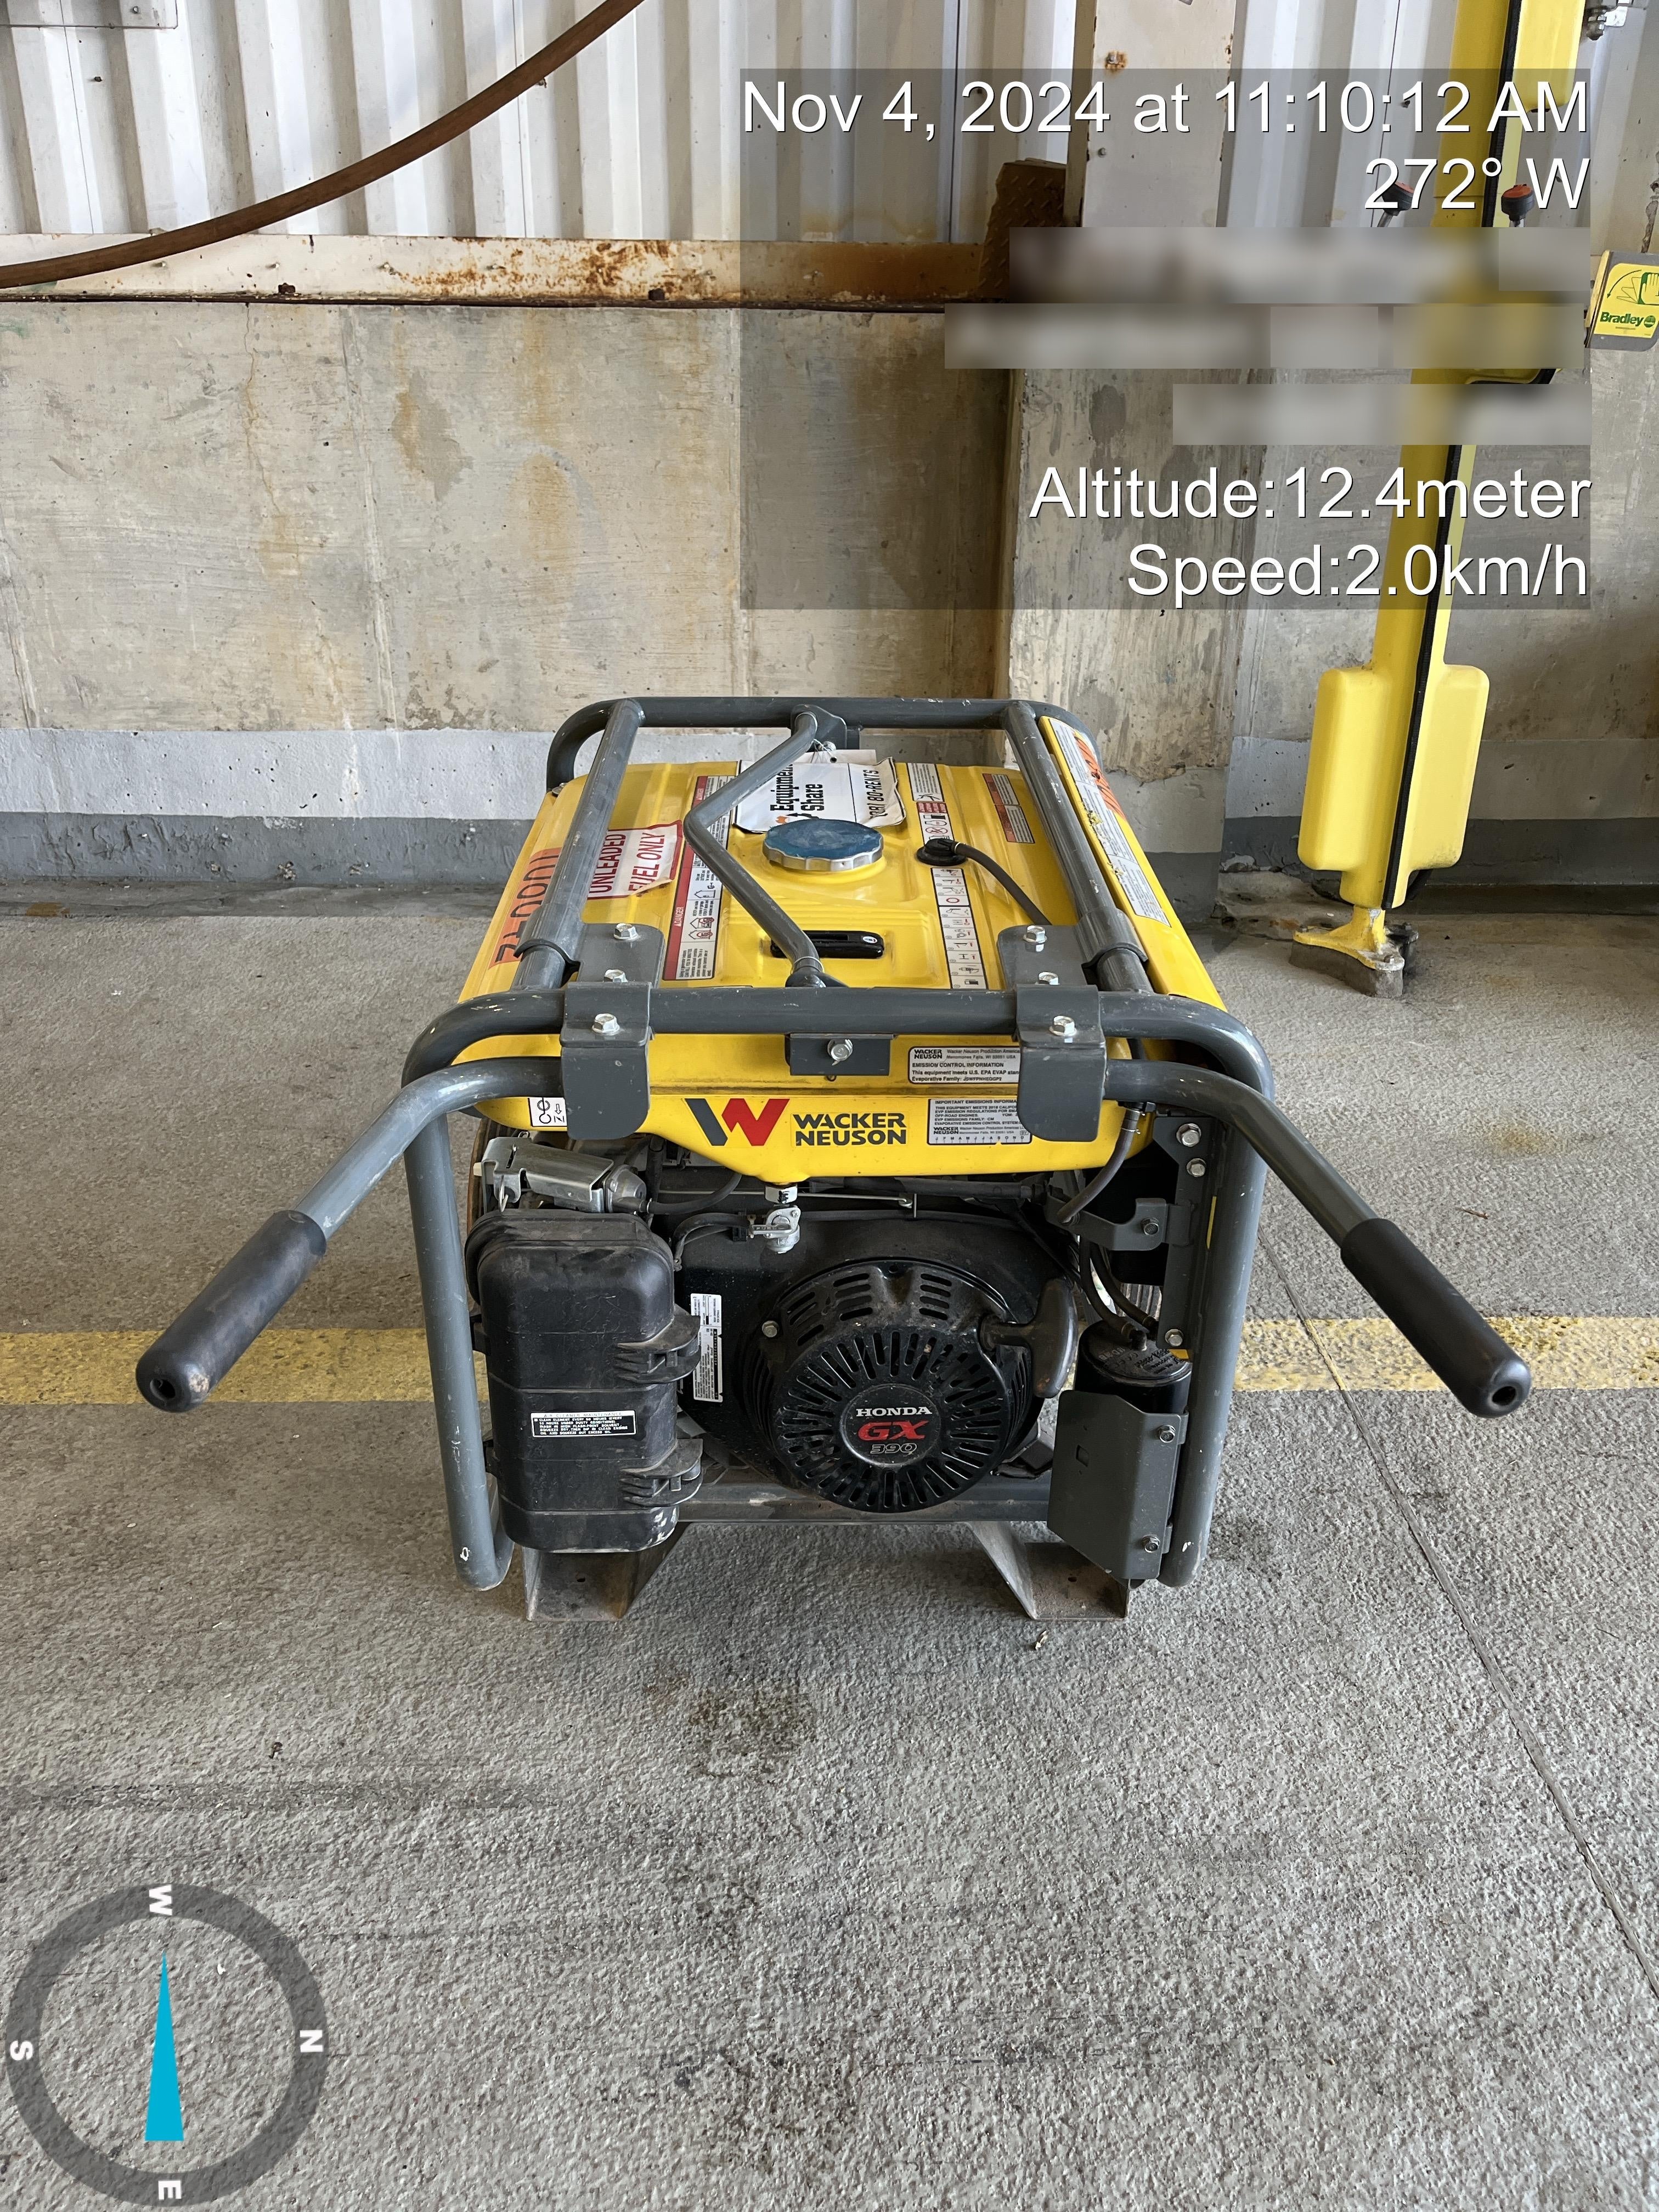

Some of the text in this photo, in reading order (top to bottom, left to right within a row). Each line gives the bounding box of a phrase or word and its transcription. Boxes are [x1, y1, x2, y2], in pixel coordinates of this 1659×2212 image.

[1600, 312, 1644, 326] Bradley
[863, 770, 884, 802] 80-RENTS
[800, 783, 825, 811] Share
[589, 834, 627, 894] UNLEADED
[628, 832, 665, 891] FUEL ONLY
[793, 1113, 907, 1129] WACKER
[795, 1130, 907, 1147] NEUSON
[856, 1407, 933, 1417] HONDA
[858, 1420, 929, 1441] GX
[870, 1443, 917, 1454] 390
